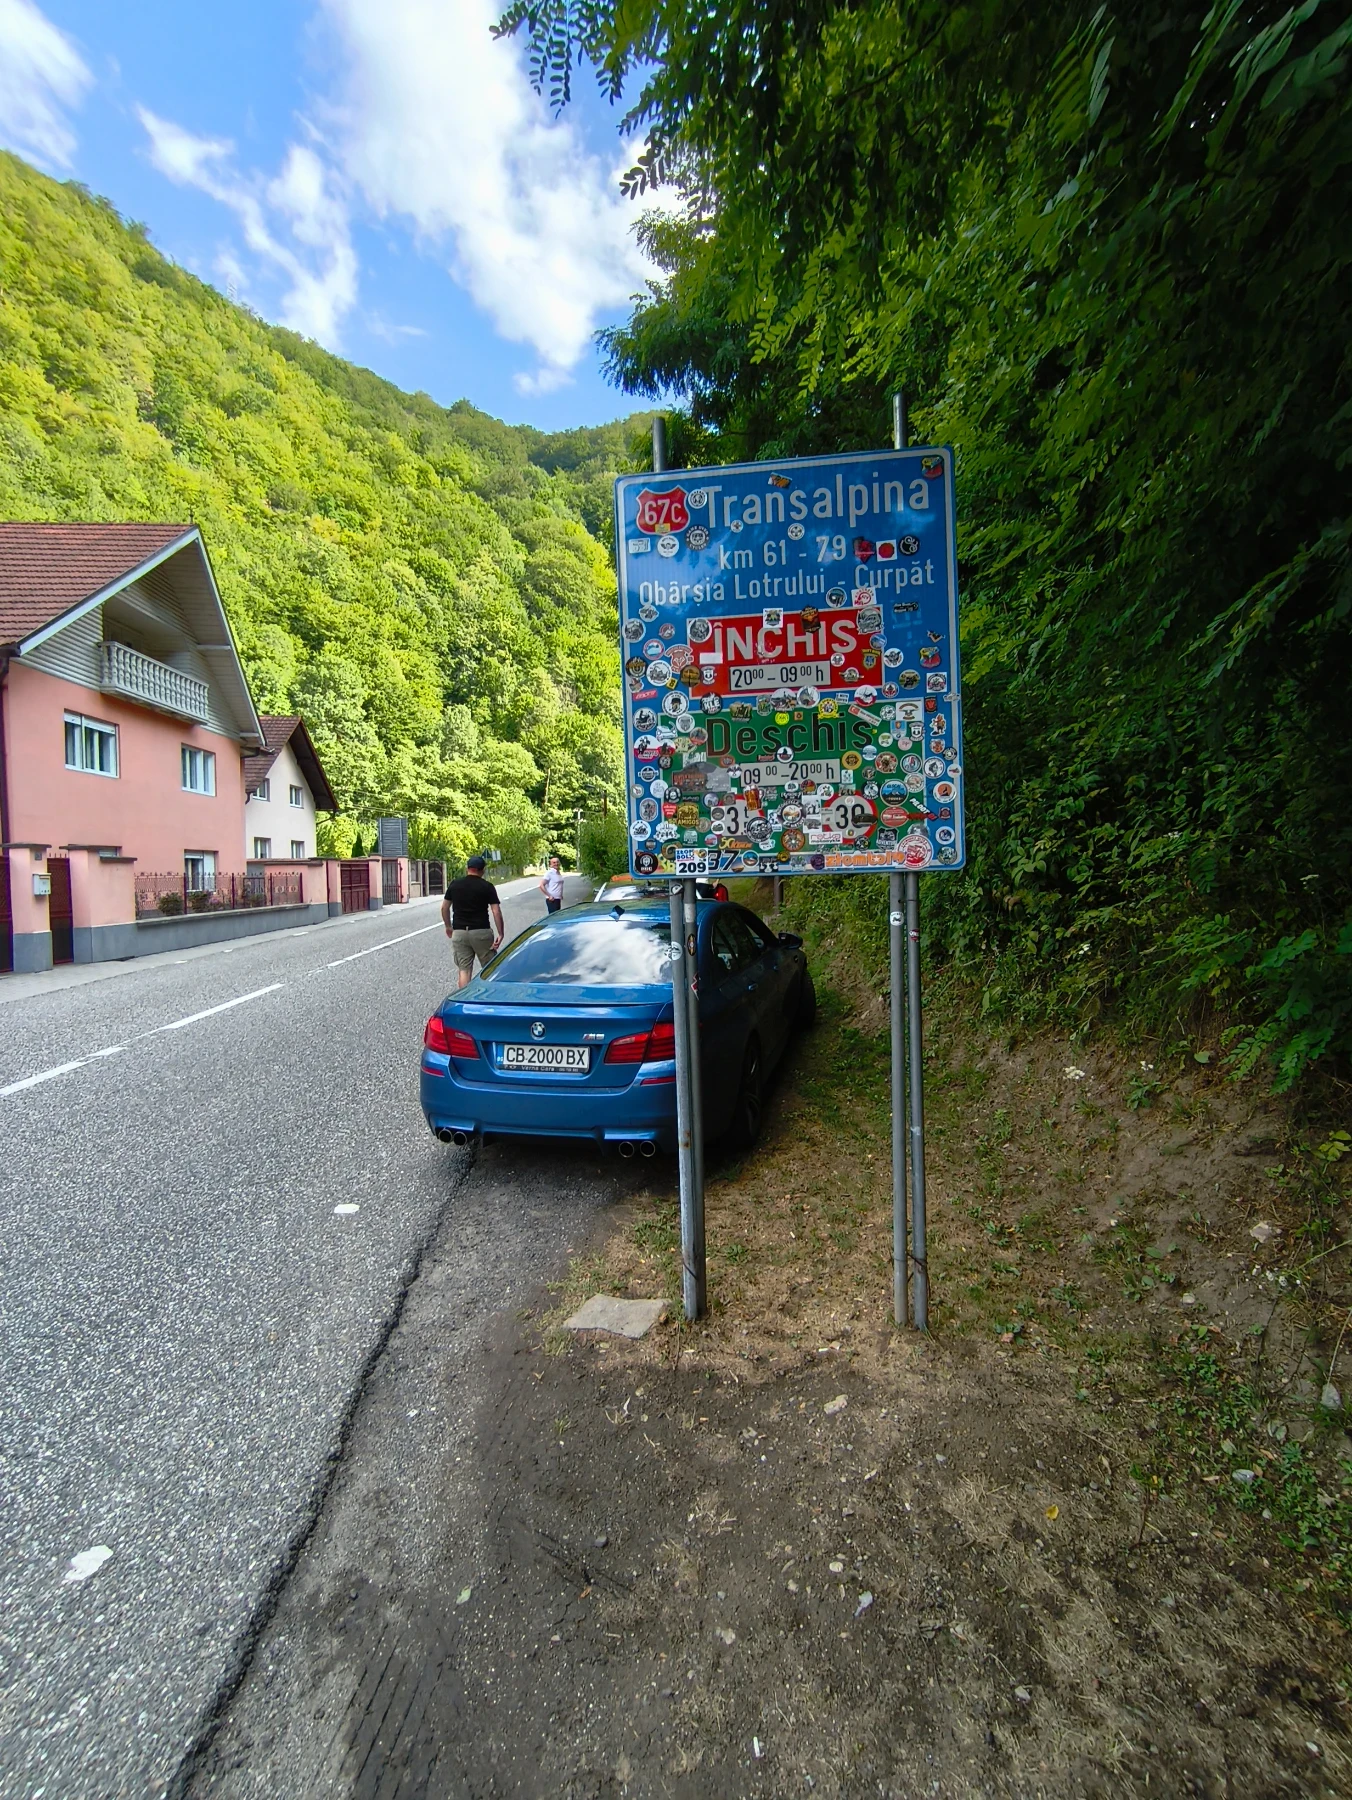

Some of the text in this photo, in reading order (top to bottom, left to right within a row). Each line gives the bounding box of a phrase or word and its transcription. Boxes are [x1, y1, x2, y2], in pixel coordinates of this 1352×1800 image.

[644, 498, 682, 526] 67C
[701, 472, 929, 529] Transalpina
[720, 544, 753, 569] km
[763, 540, 787, 566] 61
[816, 535, 846, 562] 79
[735, 568, 825, 599] Lotrului
[855, 559, 935, 594] Curpăt
[713, 619, 858, 661] ÎNCHIS
[816, 665, 824, 682] h
[706, 711, 874, 757] Deschis
[826, 763, 834, 780] h
[836, 803, 865, 829] 30
[678, 862, 707, 873] 209
[527, 1048, 564, 1064] 2000
